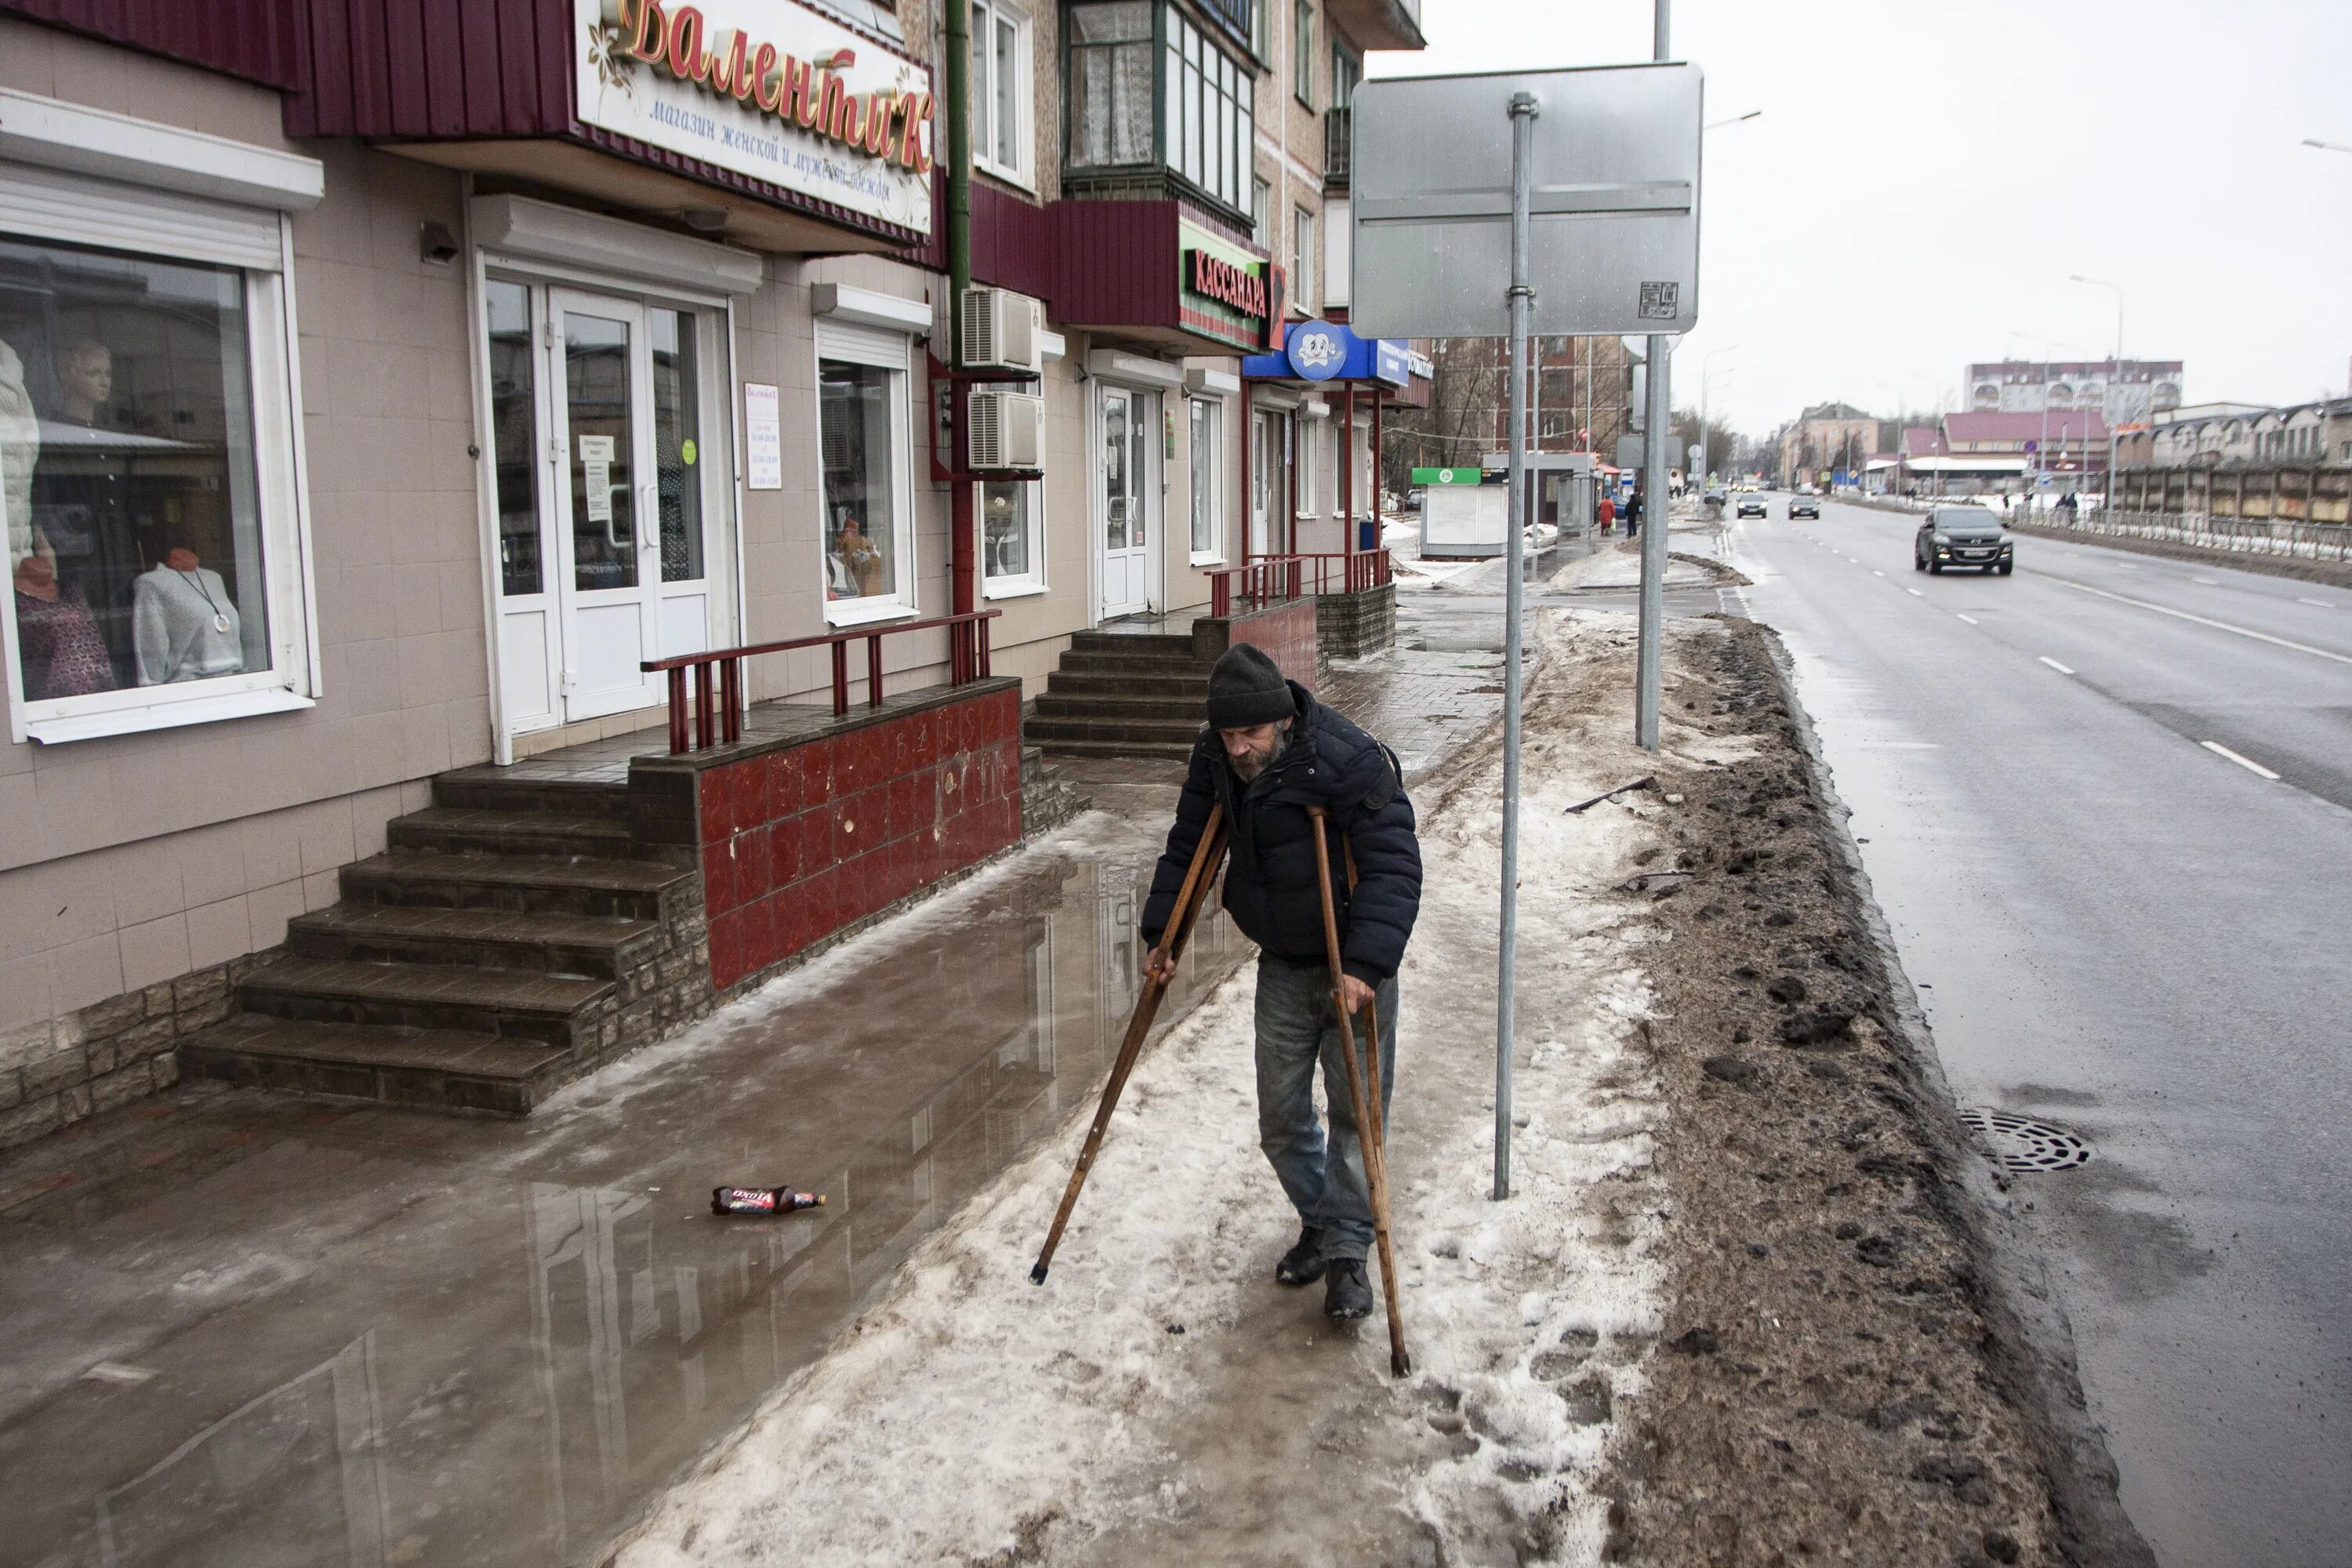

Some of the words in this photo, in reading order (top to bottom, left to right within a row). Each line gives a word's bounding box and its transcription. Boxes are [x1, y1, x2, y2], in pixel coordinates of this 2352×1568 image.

[649, 100, 715, 140] магазин
[720, 125, 778, 162] женской
[782, 147, 789, 166] и
[850, 165, 891, 201] одежды
[1195, 248, 1267, 319] КАССАНДРА
